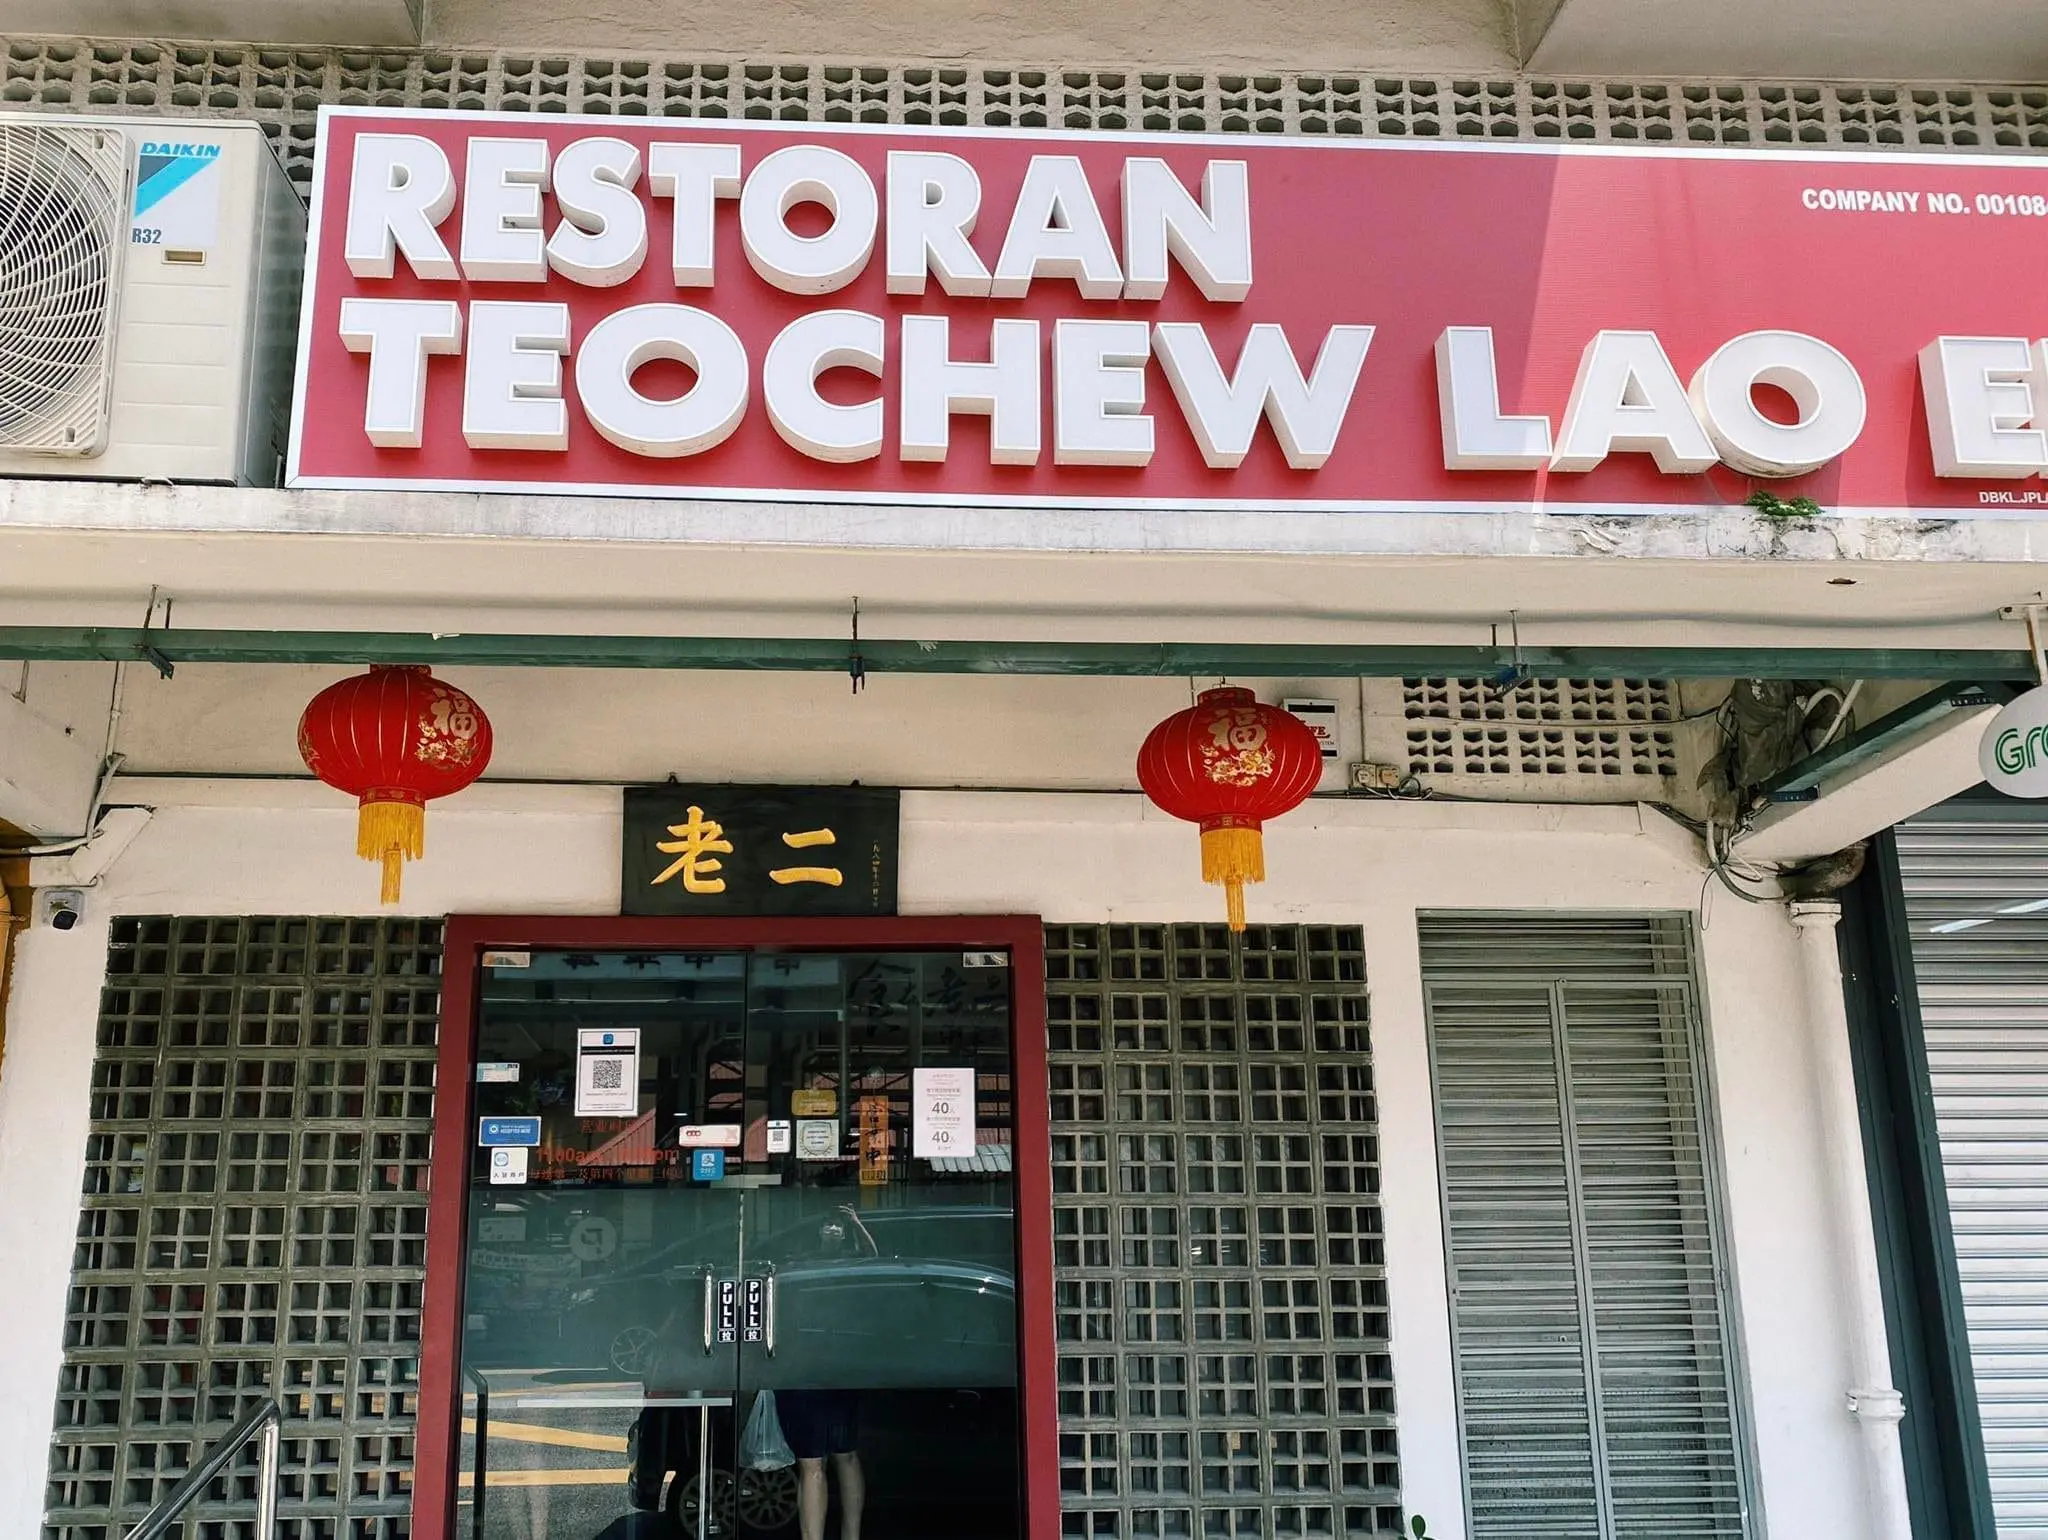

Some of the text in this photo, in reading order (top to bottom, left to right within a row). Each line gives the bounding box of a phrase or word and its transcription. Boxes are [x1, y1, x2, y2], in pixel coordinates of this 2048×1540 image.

[140, 142, 221, 157] DAIKIN
[344, 131, 1253, 303] RESTORAN
[1802, 188, 2048, 217] COMPANY NO. 00108
[131, 227, 162, 244] R32
[338, 297, 2048, 479] TEOCHEW LAO E
[932, 1101, 950, 1114] 40
[932, 1131, 950, 1144] 40
[722, 1282, 733, 1328] PULL
[749, 1281, 760, 1327] PULL
